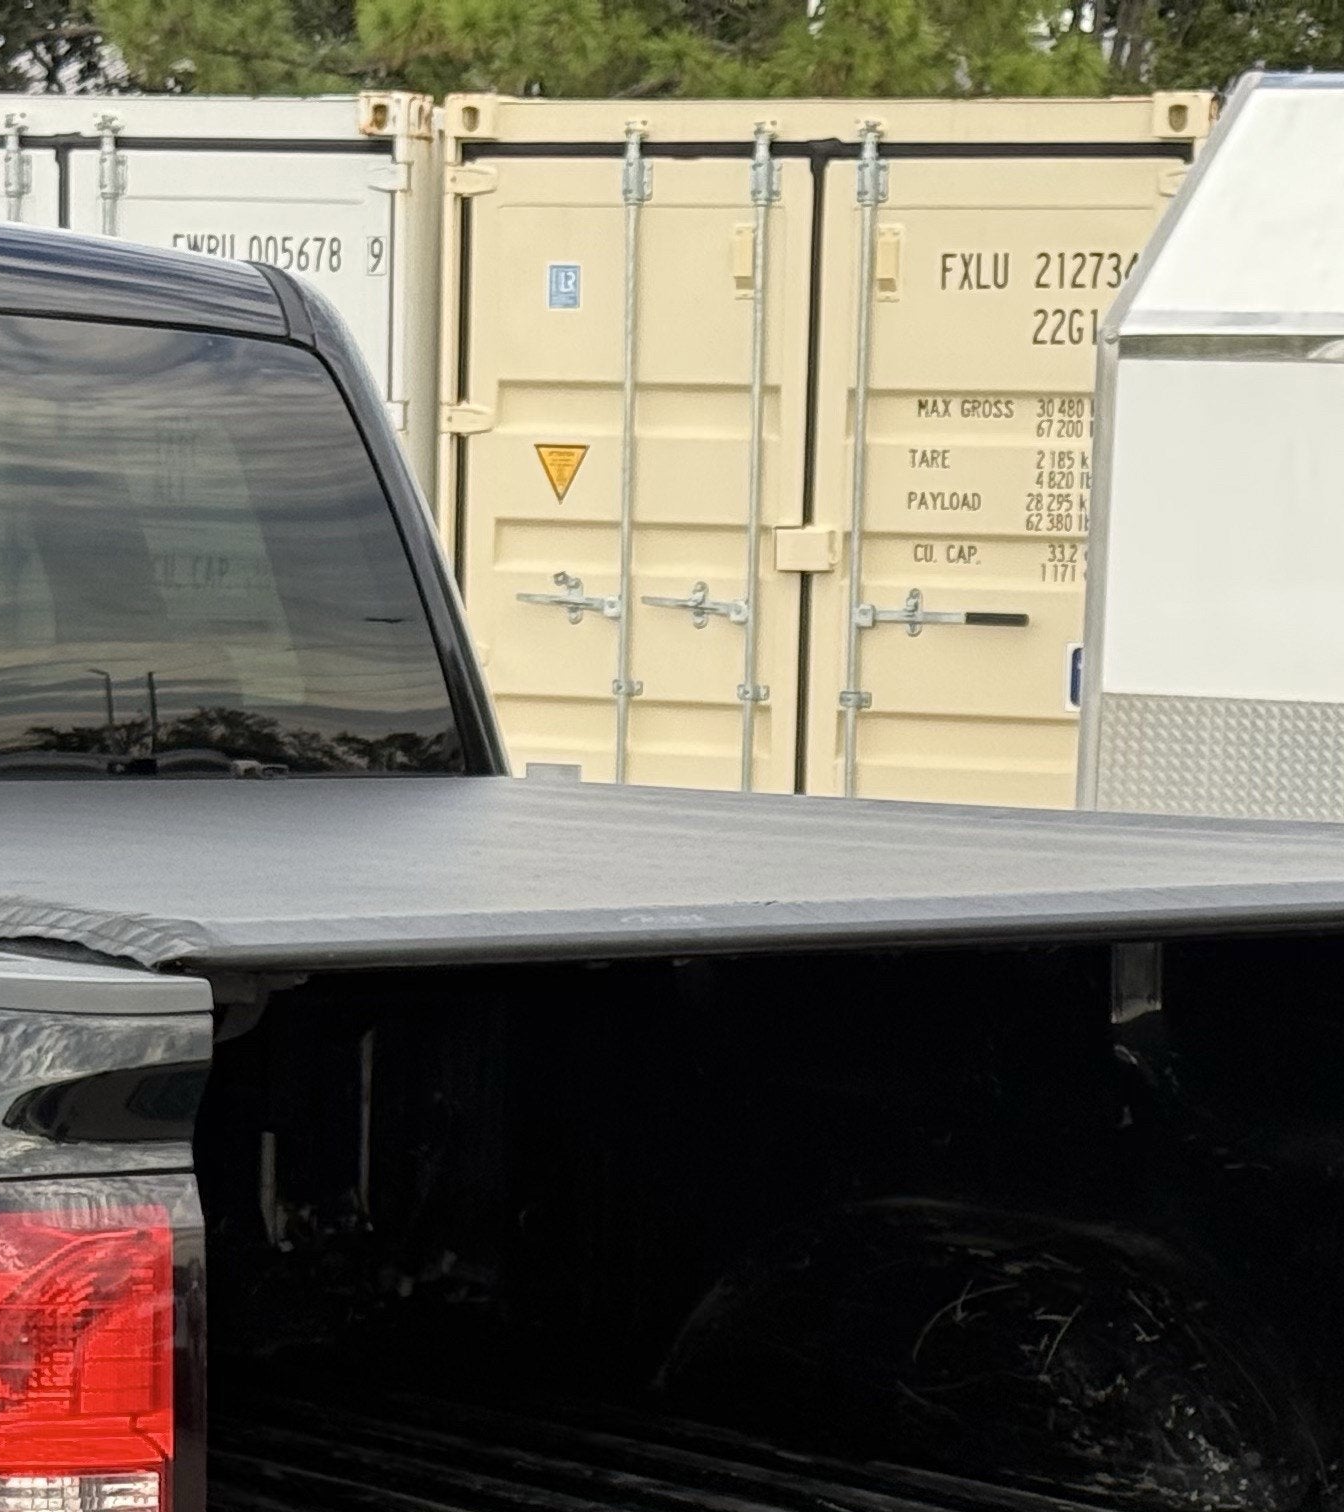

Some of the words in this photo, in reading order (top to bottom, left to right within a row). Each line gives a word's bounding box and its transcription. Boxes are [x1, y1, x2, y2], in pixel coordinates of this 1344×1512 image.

[249, 235, 342, 273] 005678
[370, 237, 384, 273] 9
[940, 252, 1010, 290] FXLU
[1032, 308, 1099, 345] 22G1
[917, 399, 952, 418] MAX
[960, 400, 1015, 419] GROSS
[908, 448, 951, 469] TARE
[907, 491, 982, 511] PAYLOAD
[913, 543, 938, 563] CU.
[946, 544, 982, 565] CAP.
